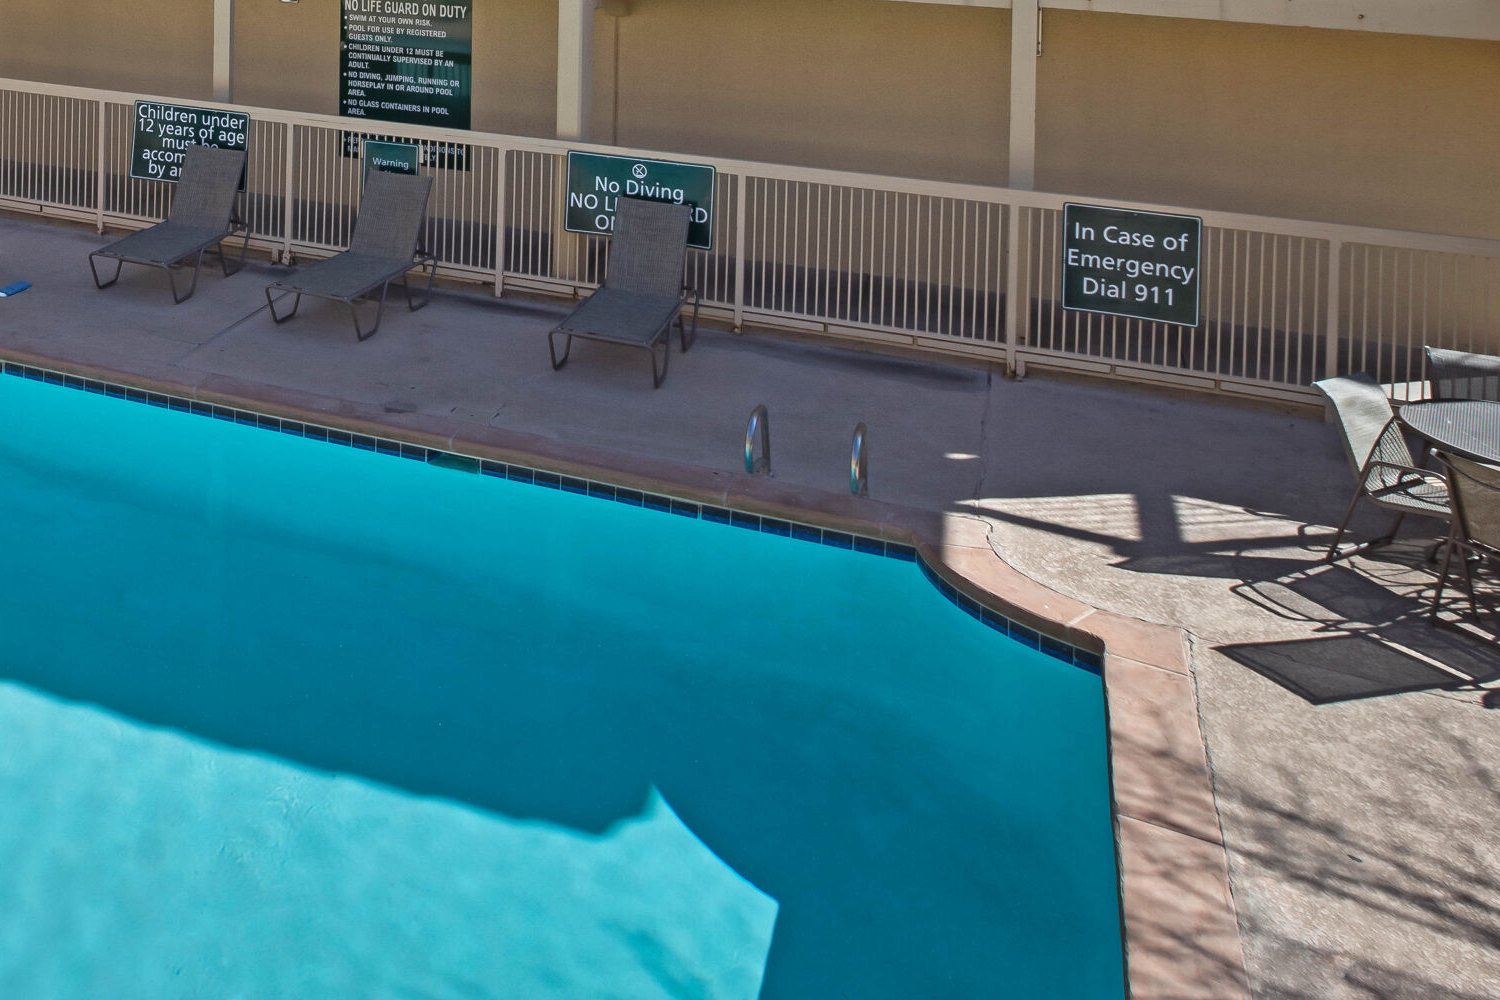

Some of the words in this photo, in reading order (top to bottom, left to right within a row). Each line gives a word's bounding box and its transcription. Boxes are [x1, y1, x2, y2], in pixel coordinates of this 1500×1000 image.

[361, 0, 382, 13] LIFE
[384, 1, 419, 16] GUARD
[422, 3, 437, 17] ON
[439, 5, 467, 19] DUTY
[349, 14, 367, 22] SWIM
[378, 16, 396, 24] YOUR
[397, 17, 414, 25] OWN
[415, 18, 433, 27] RISK.
[348, 24, 366, 32] POOL
[367, 25, 381, 33] FOR
[382, 26, 395, 34] USE
[396, 27, 405, 35] BY
[406, 28, 447, 38] REGISTERED
[348, 33, 373, 42] GUESTS
[374, 35, 393, 43] ONLY.
[348, 43, 380, 52] CHILDREN
[381, 46, 404, 54] UNDER
[414, 49, 434, 57] MUST
[435, 50, 444, 58] BE
[348, 52, 391, 62] CONTINUALLY
[392, 55, 433, 66] SUPERVISED
[434, 59, 443, 67] BY
[444, 60, 454, 68] AN
[348, 61, 370, 69] ADULT.
[348, 71, 358, 79] NO
[417, 77, 449, 86] RUNNING
[450, 80, 460, 88] OR
[348, 80, 385, 90] HORSEPLAY
[386, 83, 394, 91] IN
[406, 85, 434, 95] AROUND
[435, 88, 453, 96] POOL
[348, 89, 367, 97] AREA.
[359, 100, 380, 108] GLASS
[381, 102, 421, 112] CONTAINERS
[422, 105, 430, 113] IN
[431, 107, 450, 115] POOL
[138, 104, 197, 124] Children
[202, 114, 245, 130] under
[139, 118, 154, 133] 12
[159, 123, 195, 138] years
[198, 126, 214, 140] of
[218, 131, 245, 146] age
[148, 160, 166, 179] by
[372, 156, 410, 171] Warning
[595, 176, 620, 193] No
[626, 179, 684, 205] Diving
[570, 192, 599, 210] NO
[1075, 222, 1095, 241] In
[1103, 226, 1155, 248] Case
[1163, 233, 1189, 252] of
[1067, 248, 1195, 285] Emergency
[1082, 277, 1126, 299] Dial
[1134, 284, 1174, 306] 911
